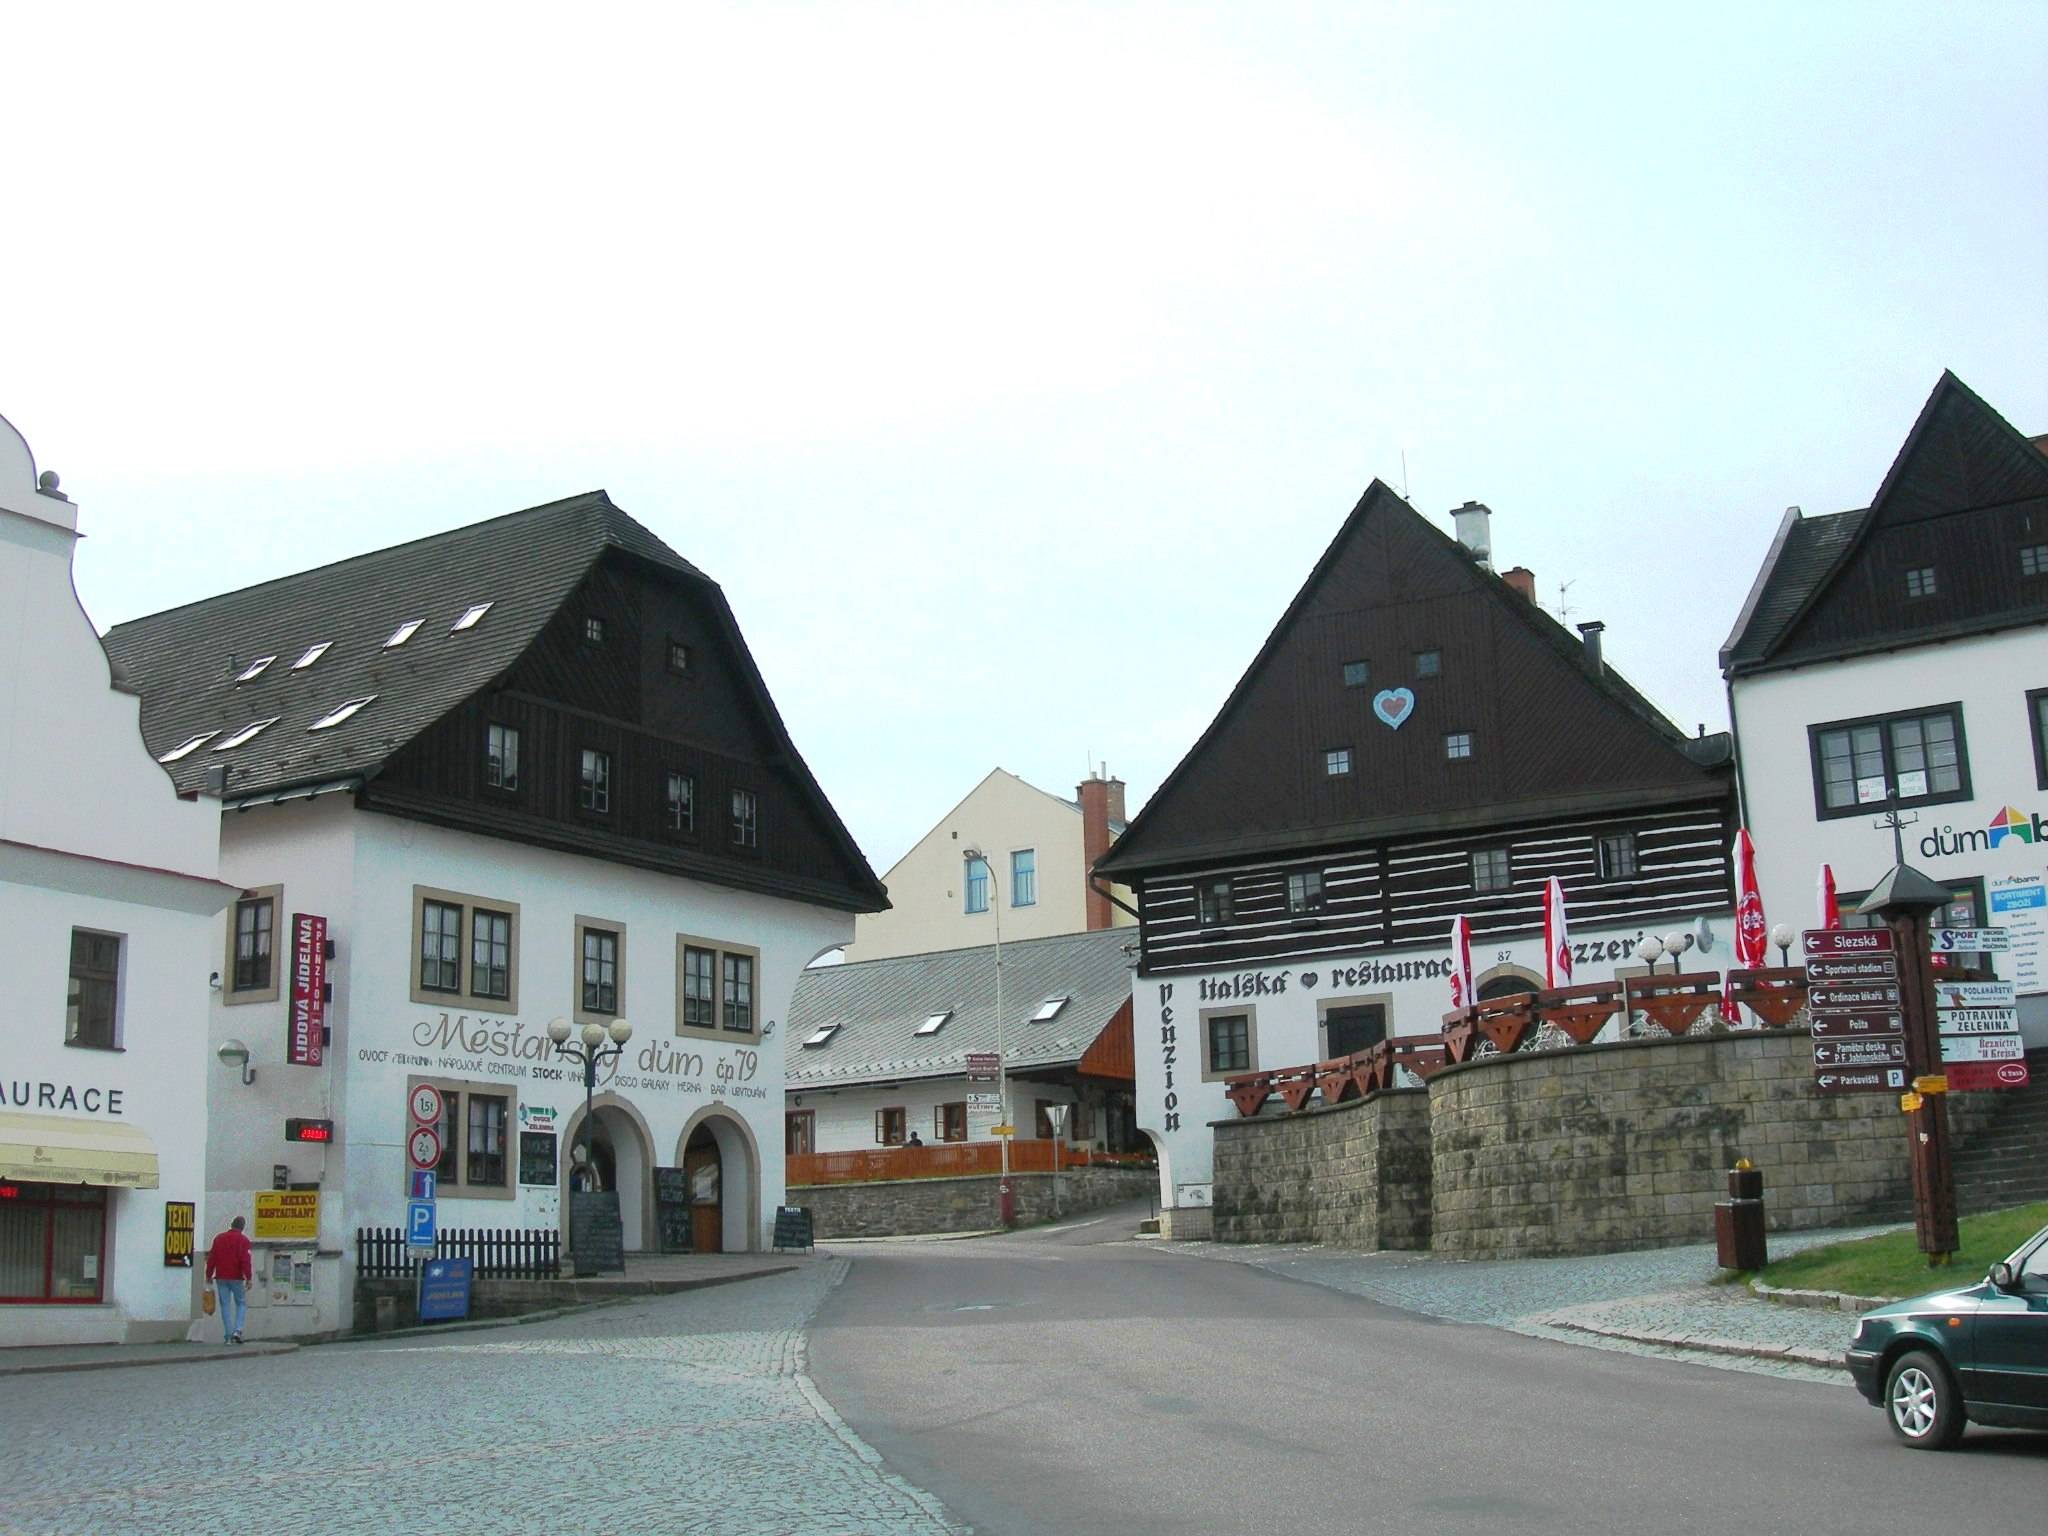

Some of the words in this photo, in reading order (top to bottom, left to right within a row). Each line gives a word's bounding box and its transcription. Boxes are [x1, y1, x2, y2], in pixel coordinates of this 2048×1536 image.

[1920, 825, 1989, 858] dům
[1834, 936, 1878, 948] Slezská
[1940, 930, 1979, 950] SPORT
[296, 918, 313, 993] JÍDELNA
[1497, 951, 1512, 961] 87
[312, 933, 323, 1011] PENZION
[1331, 956, 1454, 988] restaurac
[1849, 1019, 1869, 1029] Pošta
[1951, 1010, 2013, 1021] POTRAVINY
[1957, 1021, 2010, 1032] ZELENINA
[295, 999, 309, 1062] LIDOVÁ
[637, 1040, 704, 1077] dům
[734, 1048, 759, 1082] 79
[487, 1062, 527, 1078] CENTRUM
[532, 1067, 563, 1082] STOCK
[640, 1078, 670, 1092] GALAXY
[677, 1081, 702, 1094] HERNA
[710, 1085, 726, 1096] BAR
[280, 1195, 316, 1206] MEXICO
[168, 1205, 193, 1228] TEXTIL
[257, 1207, 316, 1219] RESTAURANT
[414, 1208, 430, 1232] P
[167, 1230, 193, 1254] OBUV
